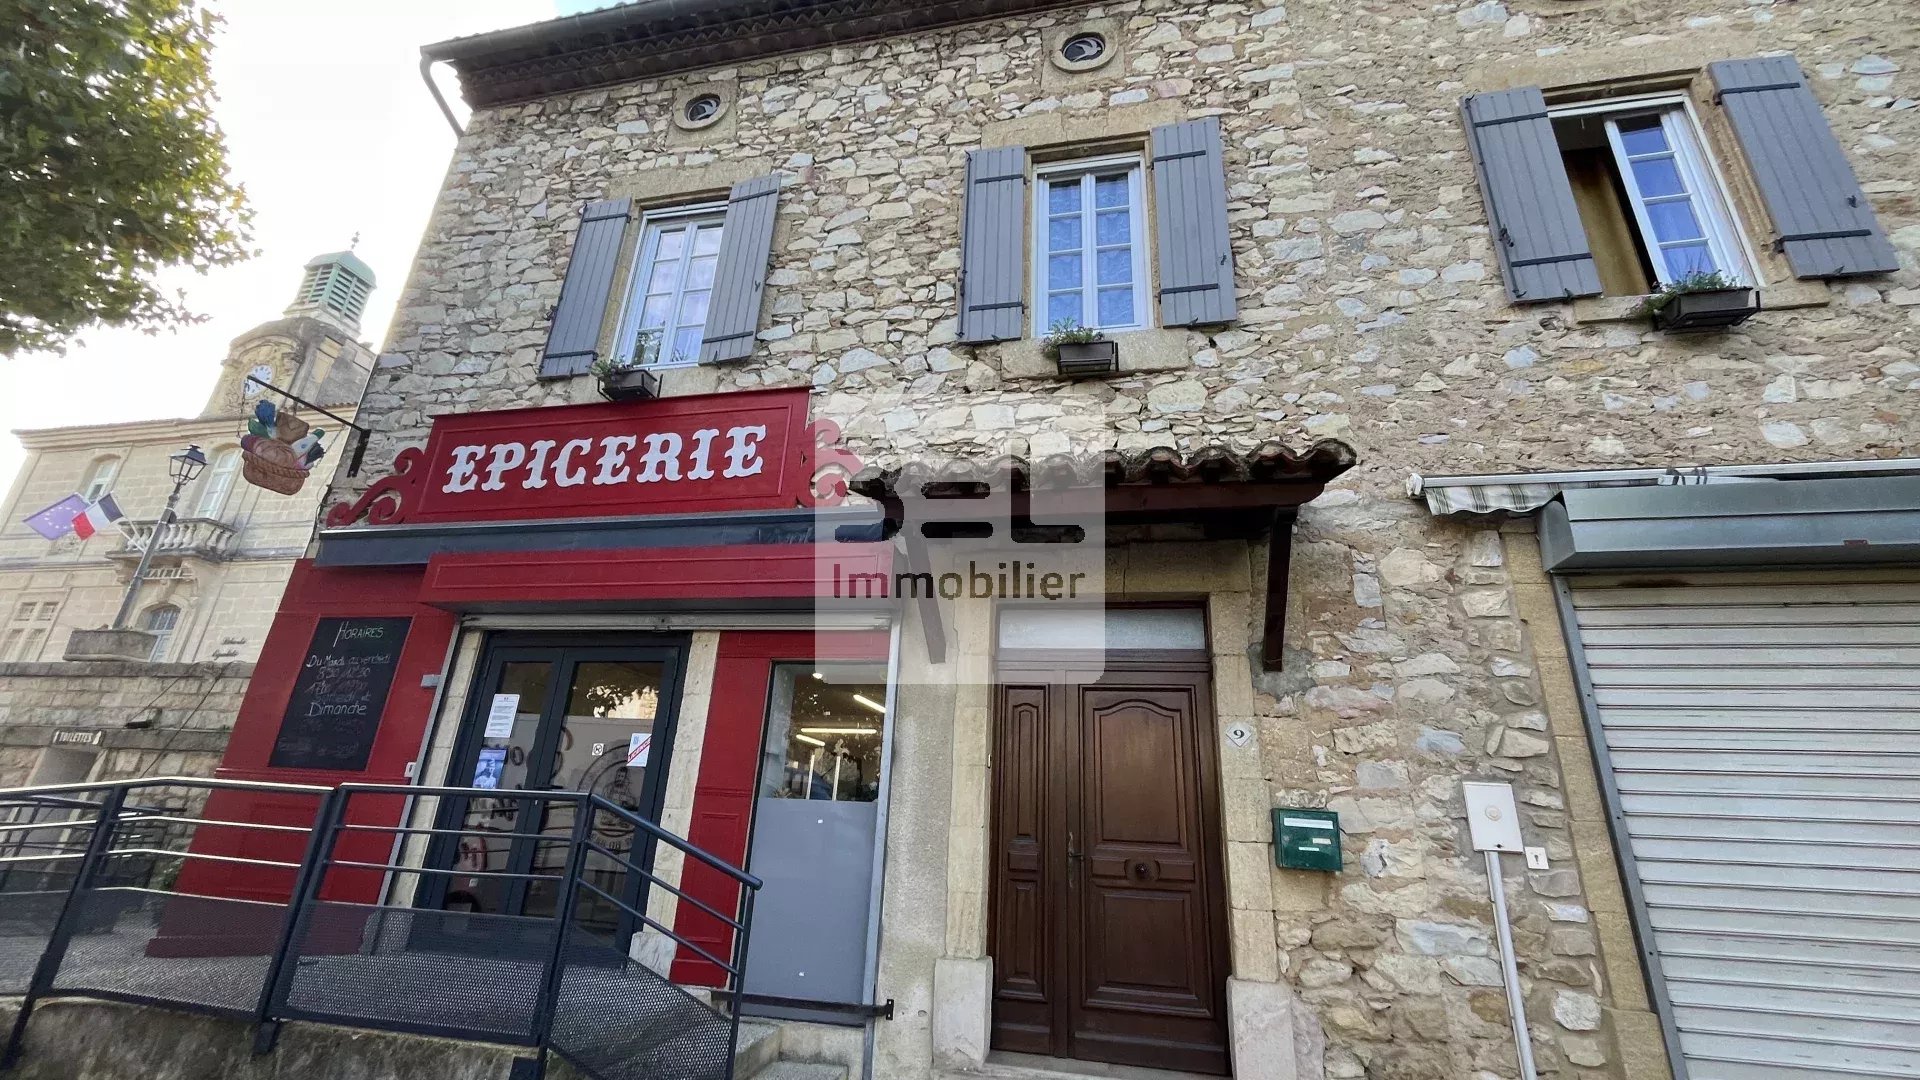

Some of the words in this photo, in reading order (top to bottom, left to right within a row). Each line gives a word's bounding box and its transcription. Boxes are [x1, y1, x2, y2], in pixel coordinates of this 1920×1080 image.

[442, 424, 766, 494] EPICERIE
[304, 700, 367, 717] Dimanche
[59, 731, 94, 743] TOILETTES
[1233, 729, 1245, 740] 9
